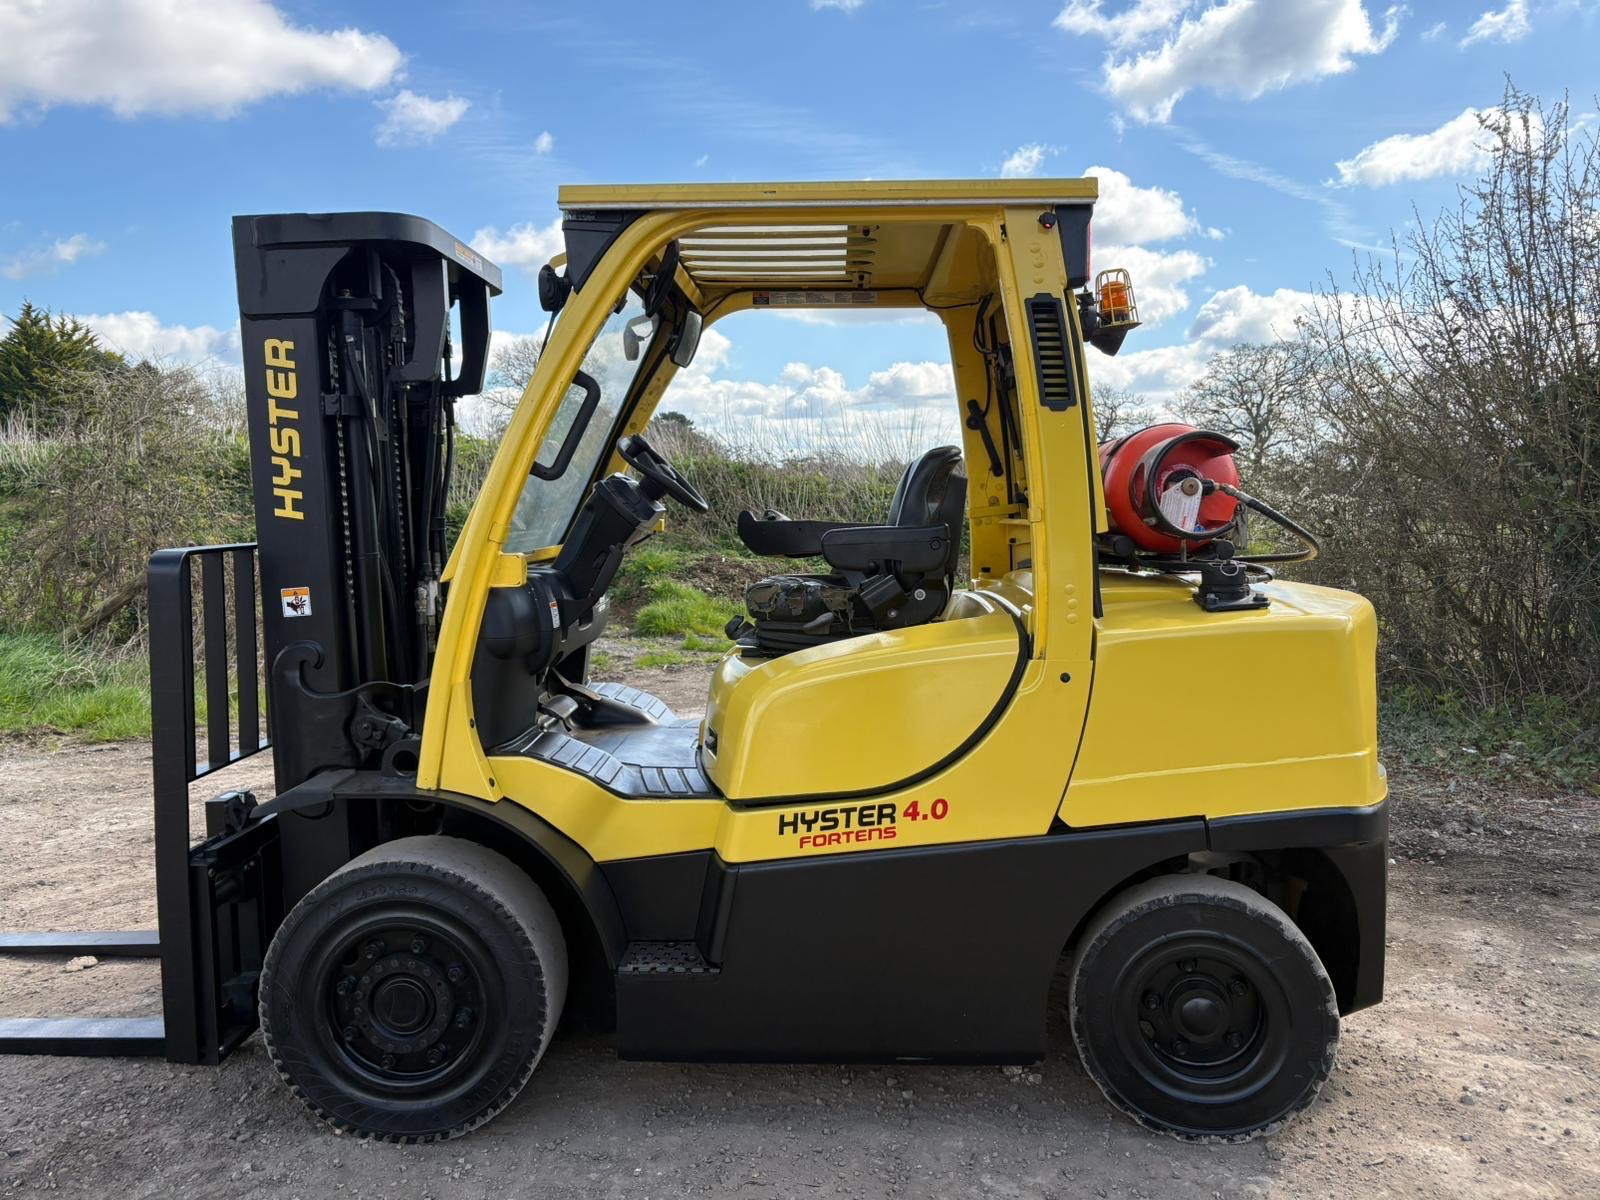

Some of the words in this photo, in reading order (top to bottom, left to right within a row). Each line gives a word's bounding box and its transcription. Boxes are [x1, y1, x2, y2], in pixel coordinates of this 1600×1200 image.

[264, 338, 305, 520] HYSTER
[778, 803, 897, 835] HYSTER
[902, 799, 949, 821] 4.0
[799, 826, 897, 849] FORTENS
